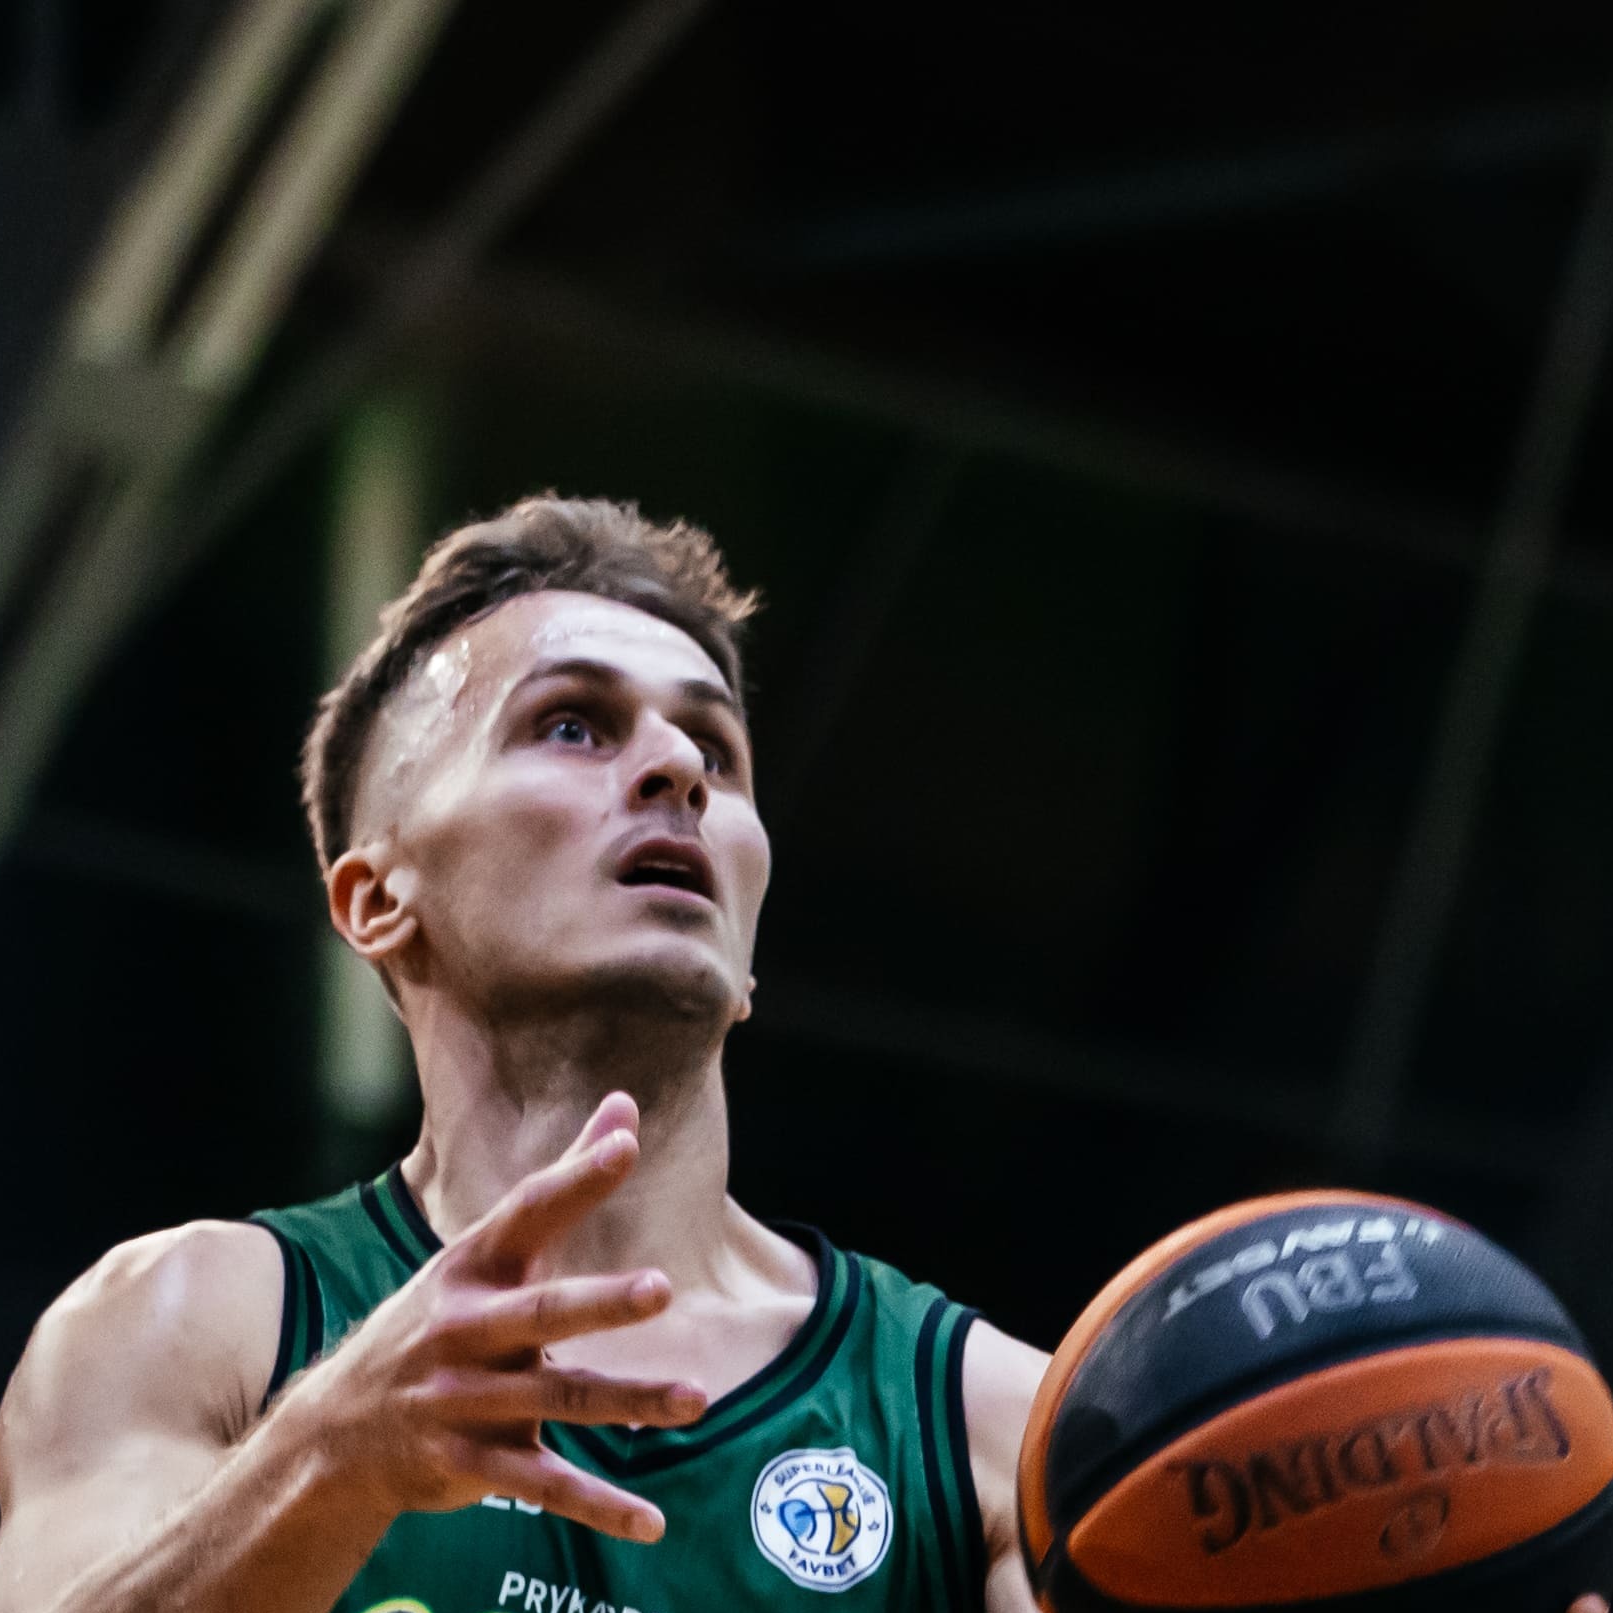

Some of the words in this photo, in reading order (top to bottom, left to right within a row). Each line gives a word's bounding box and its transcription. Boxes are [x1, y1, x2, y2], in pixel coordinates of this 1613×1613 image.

[1241, 1243, 1419, 1340] FBU
[1182, 1366, 1571, 1557] SPALDING
[789, 1550, 856, 1577] FAVBET
